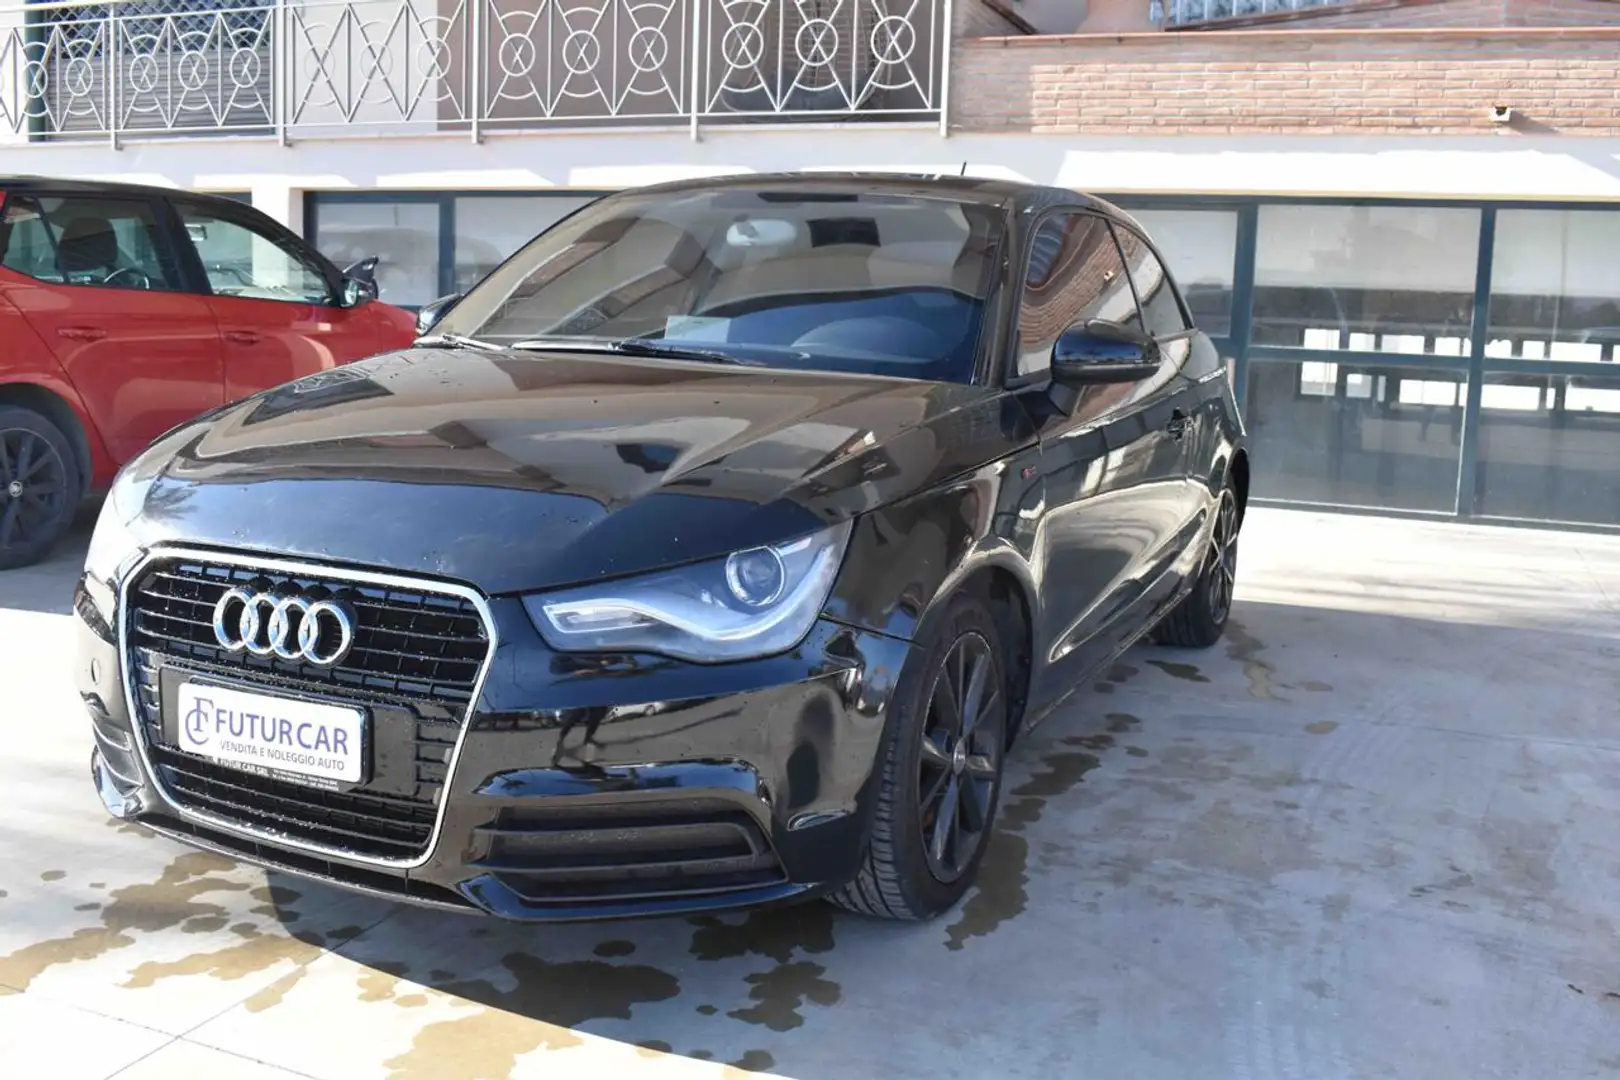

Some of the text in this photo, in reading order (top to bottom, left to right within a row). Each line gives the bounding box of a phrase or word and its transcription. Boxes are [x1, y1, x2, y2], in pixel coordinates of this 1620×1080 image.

[220, 740, 345, 770] VENDITA E NOLEGGIO AUTO
